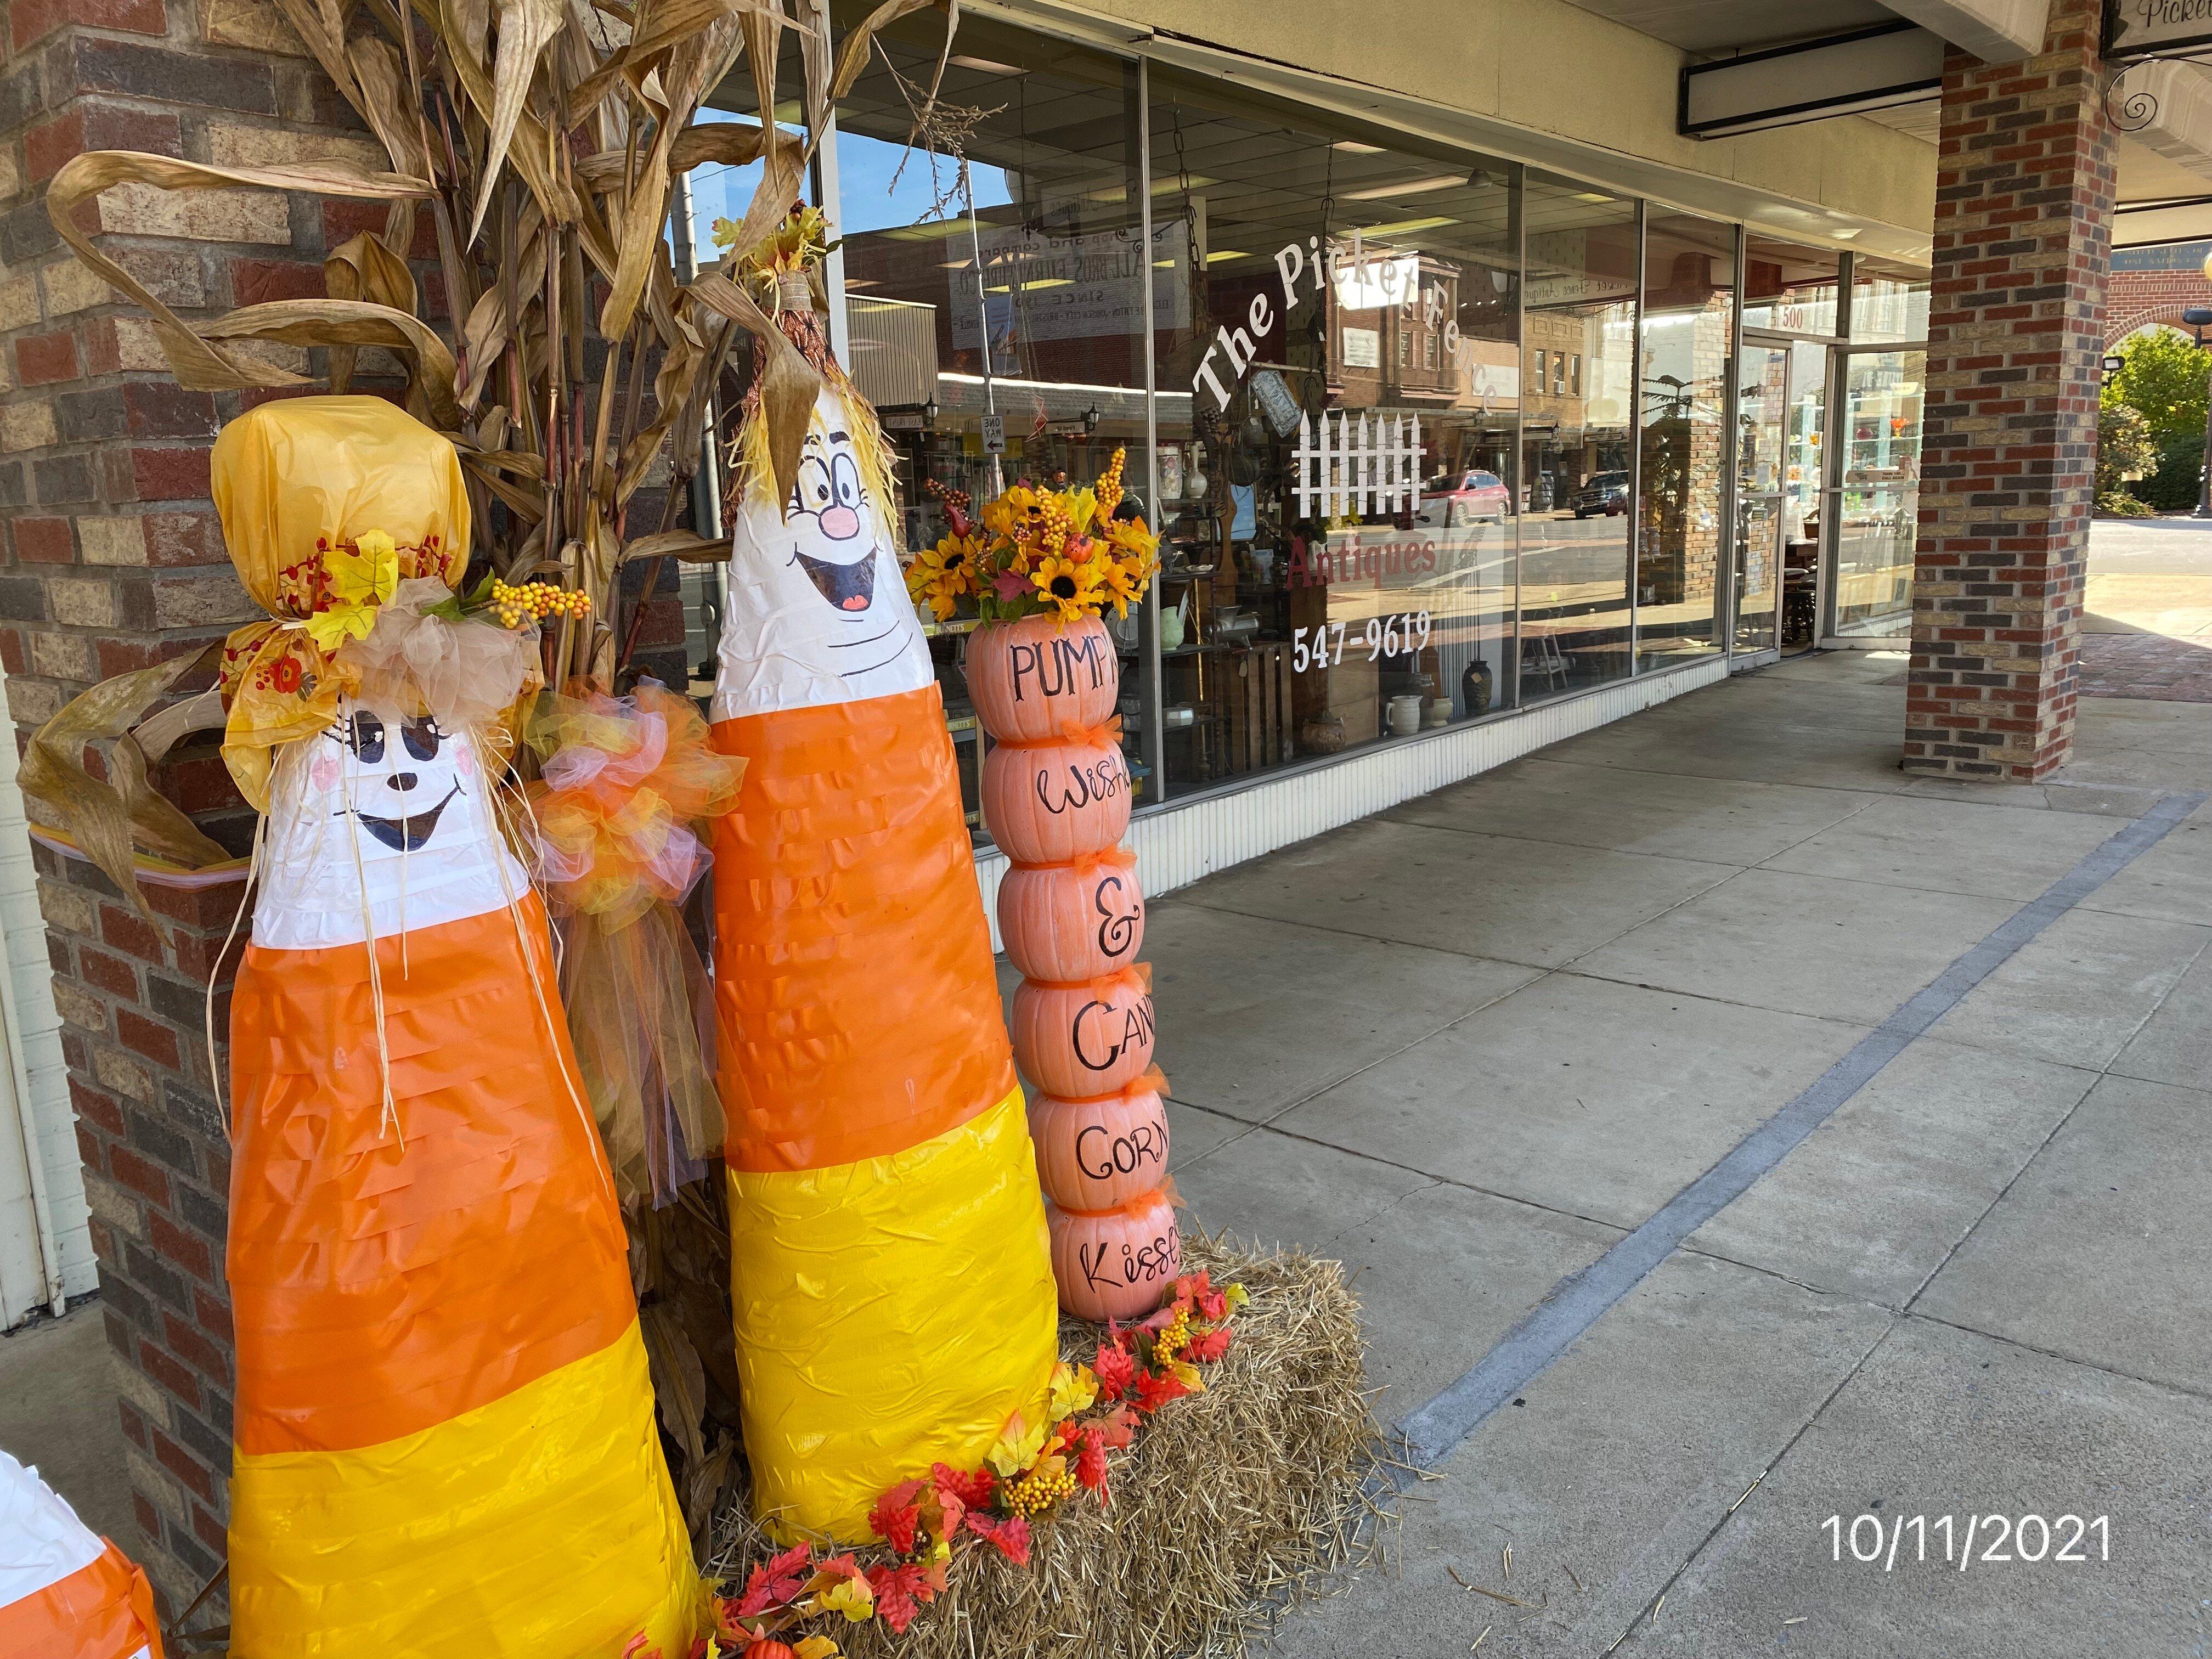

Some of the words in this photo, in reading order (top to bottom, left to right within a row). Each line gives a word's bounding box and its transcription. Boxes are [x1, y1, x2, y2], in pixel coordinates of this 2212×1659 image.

[1192, 293, 1273, 413] The
[1274, 228, 1418, 312] Picket
[1426, 280, 1498, 417] Fence
[1783, 307, 1803, 330] 500
[1286, 536, 1436, 590] Antiques
[1294, 610, 1431, 673] 547-9619
[1096, 877, 1139, 957] &
[1073, 994, 1155, 1070] CAN
